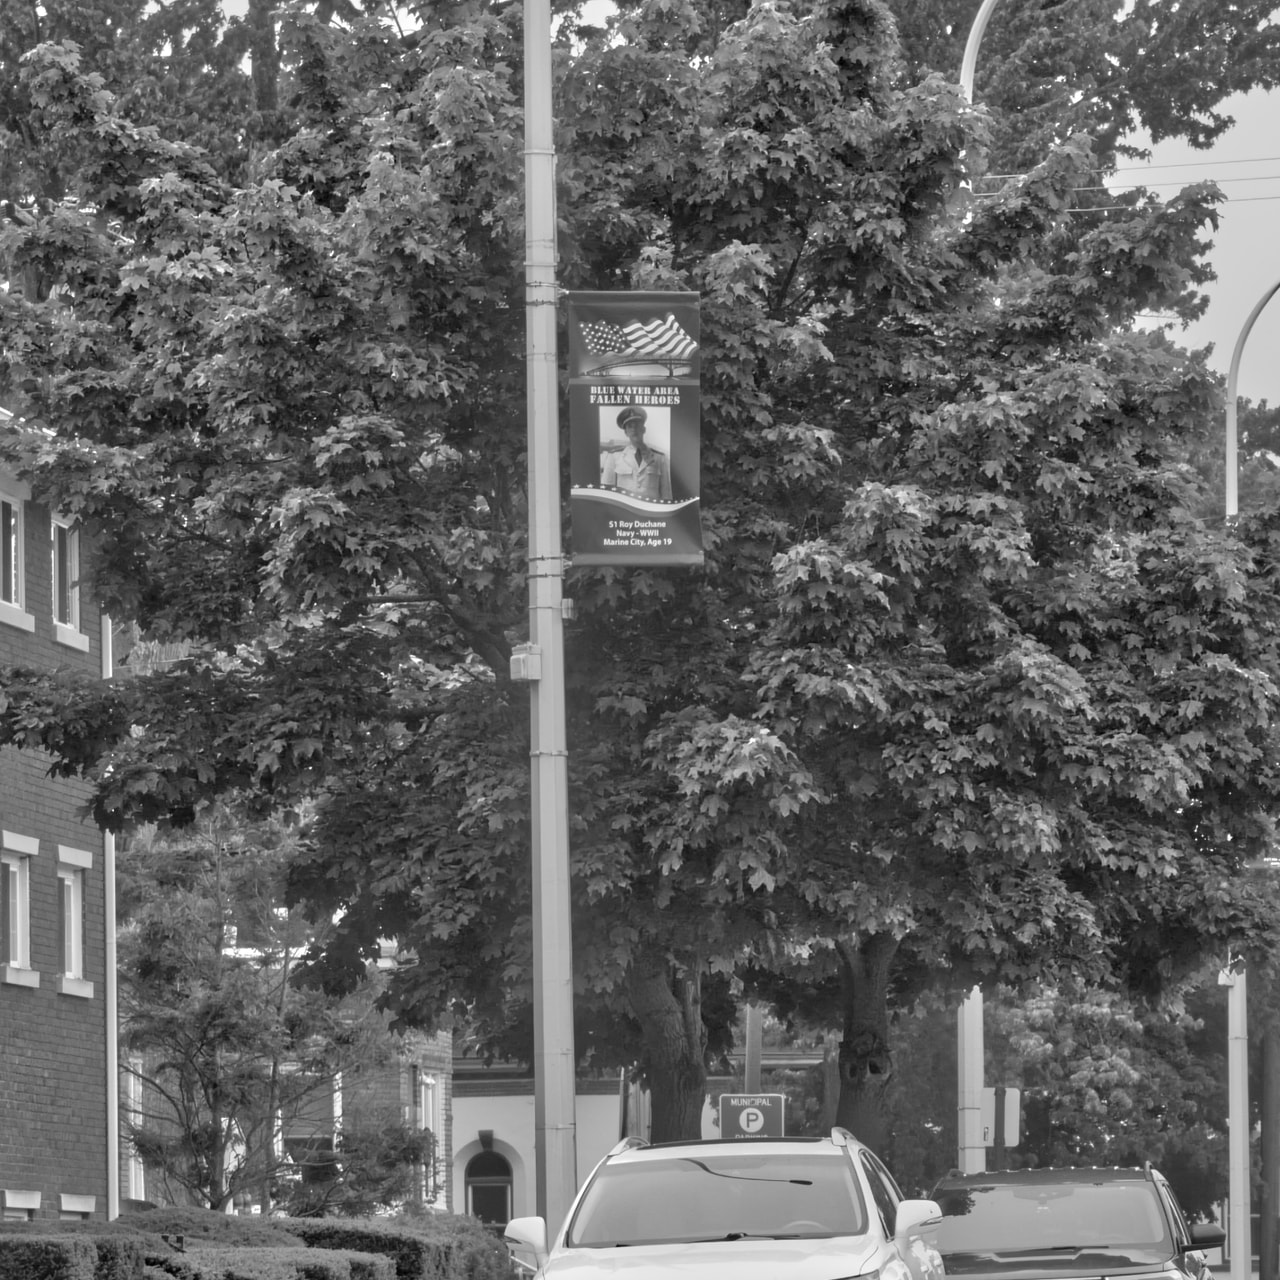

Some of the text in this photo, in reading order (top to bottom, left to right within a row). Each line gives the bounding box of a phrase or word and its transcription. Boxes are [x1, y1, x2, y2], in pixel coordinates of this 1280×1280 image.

[590, 386, 680, 395] BLUE WATER AREA
[590, 395, 681, 404] FALLEN HEROES
[619, 521, 633, 530] Roy
[634, 520, 666, 528] Duchane
[616, 529, 635, 538] Navy
[640, 529, 659, 537] WWII
[603, 538, 629, 546] Marine
[630, 538, 646, 547] City,
[647, 538, 662, 547] Age
[730, 1098, 772, 1107] MUNICIPAL
